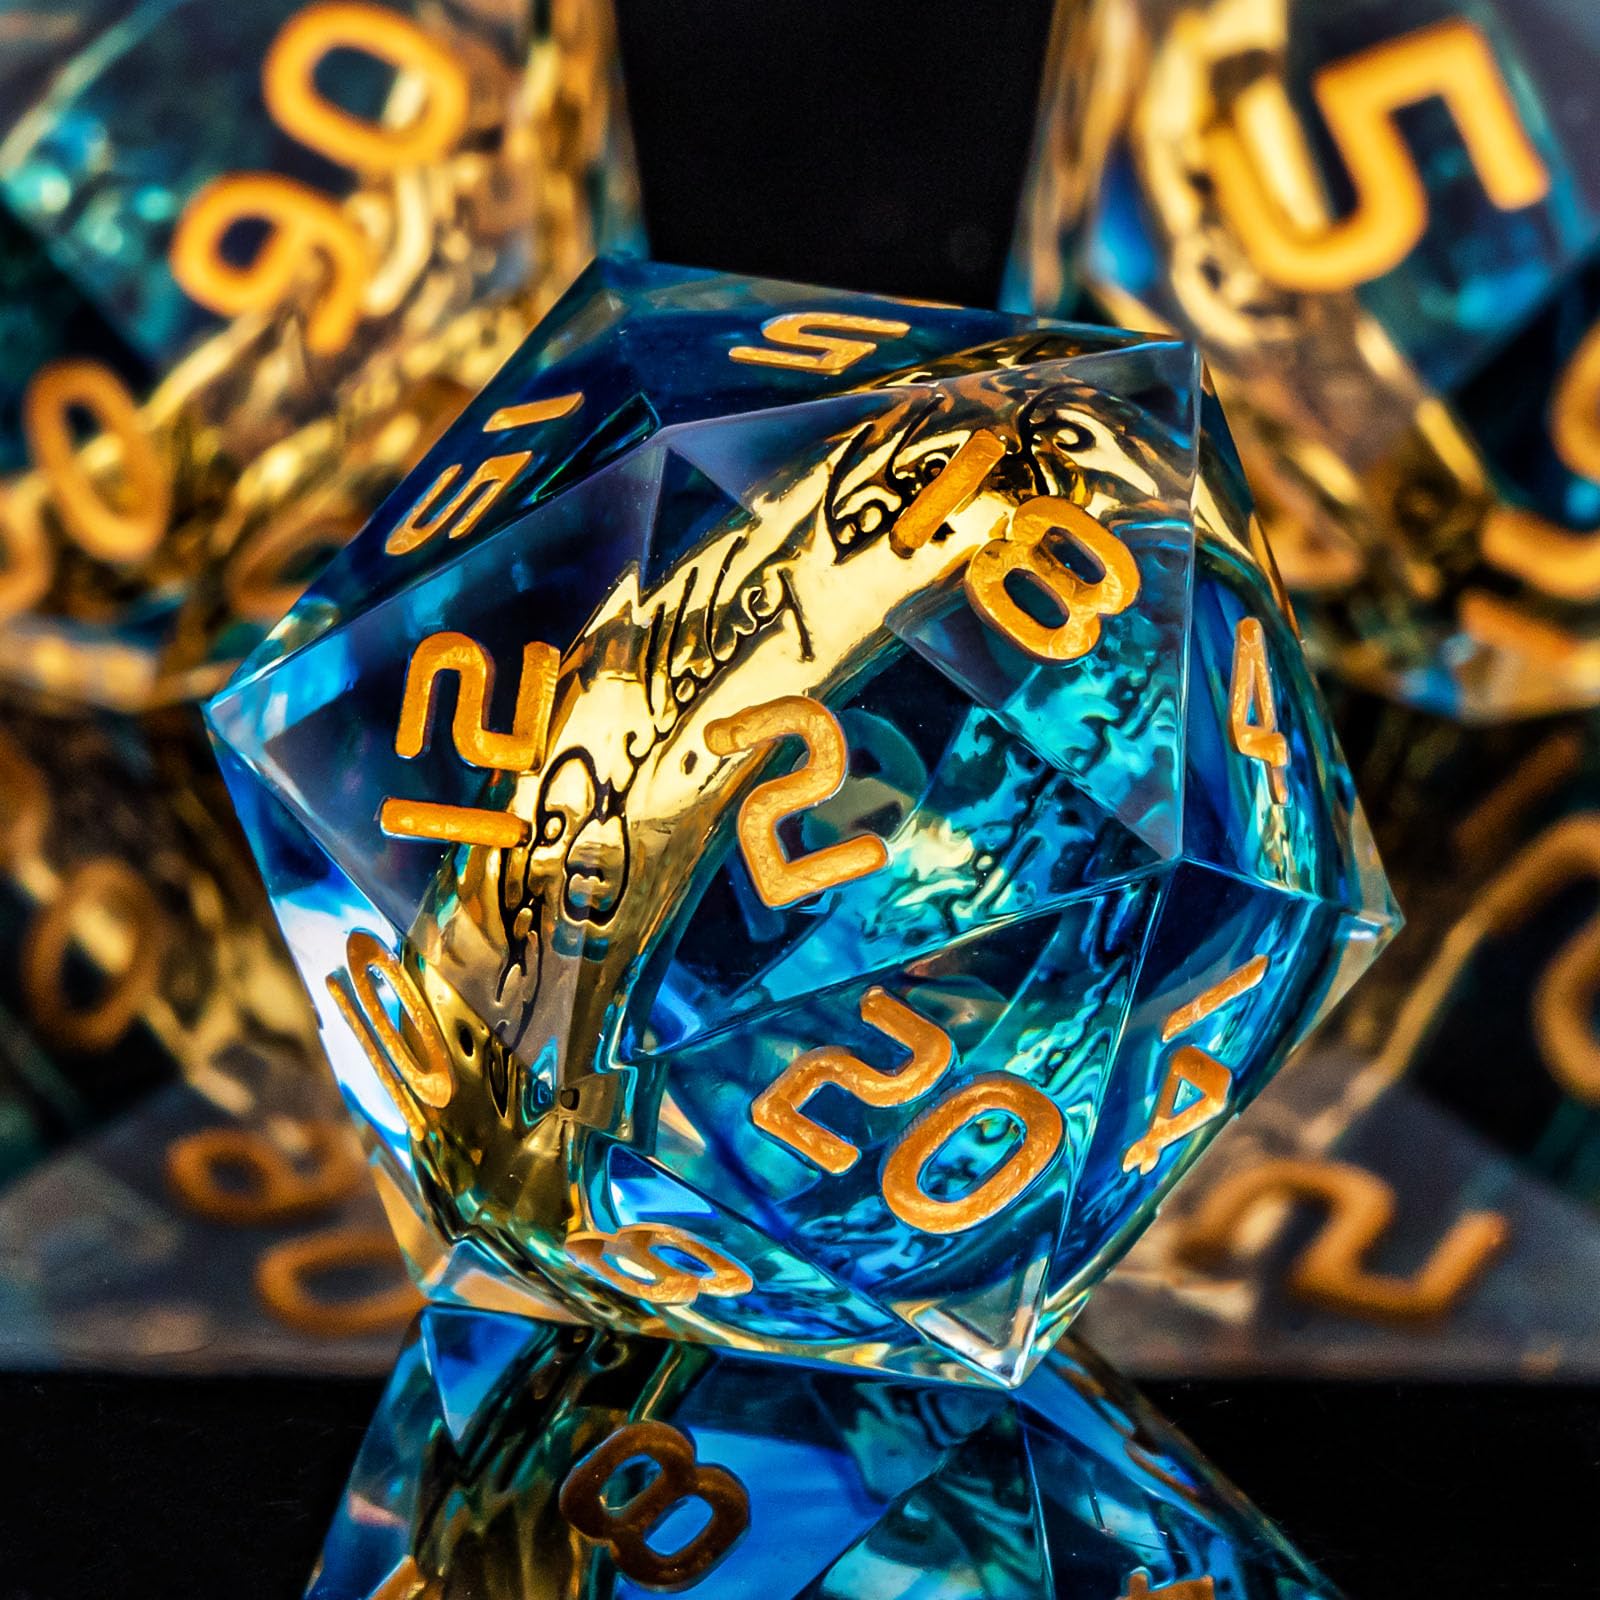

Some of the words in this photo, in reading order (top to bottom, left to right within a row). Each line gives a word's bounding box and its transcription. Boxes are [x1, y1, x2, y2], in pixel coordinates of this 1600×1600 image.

[1212, 18, 1550, 292] 5
[728, 312, 911, 374] 5
[385, 391, 584, 556] 15
[892, 428, 1140, 662] 18
[379, 631, 561, 849] 12
[703, 695, 890, 909] 2
[1234, 616, 1289, 805] 4
[325, 930, 452, 1141] 10
[751, 985, 1064, 1235] 20
[1121, 954, 1269, 1175] 14
